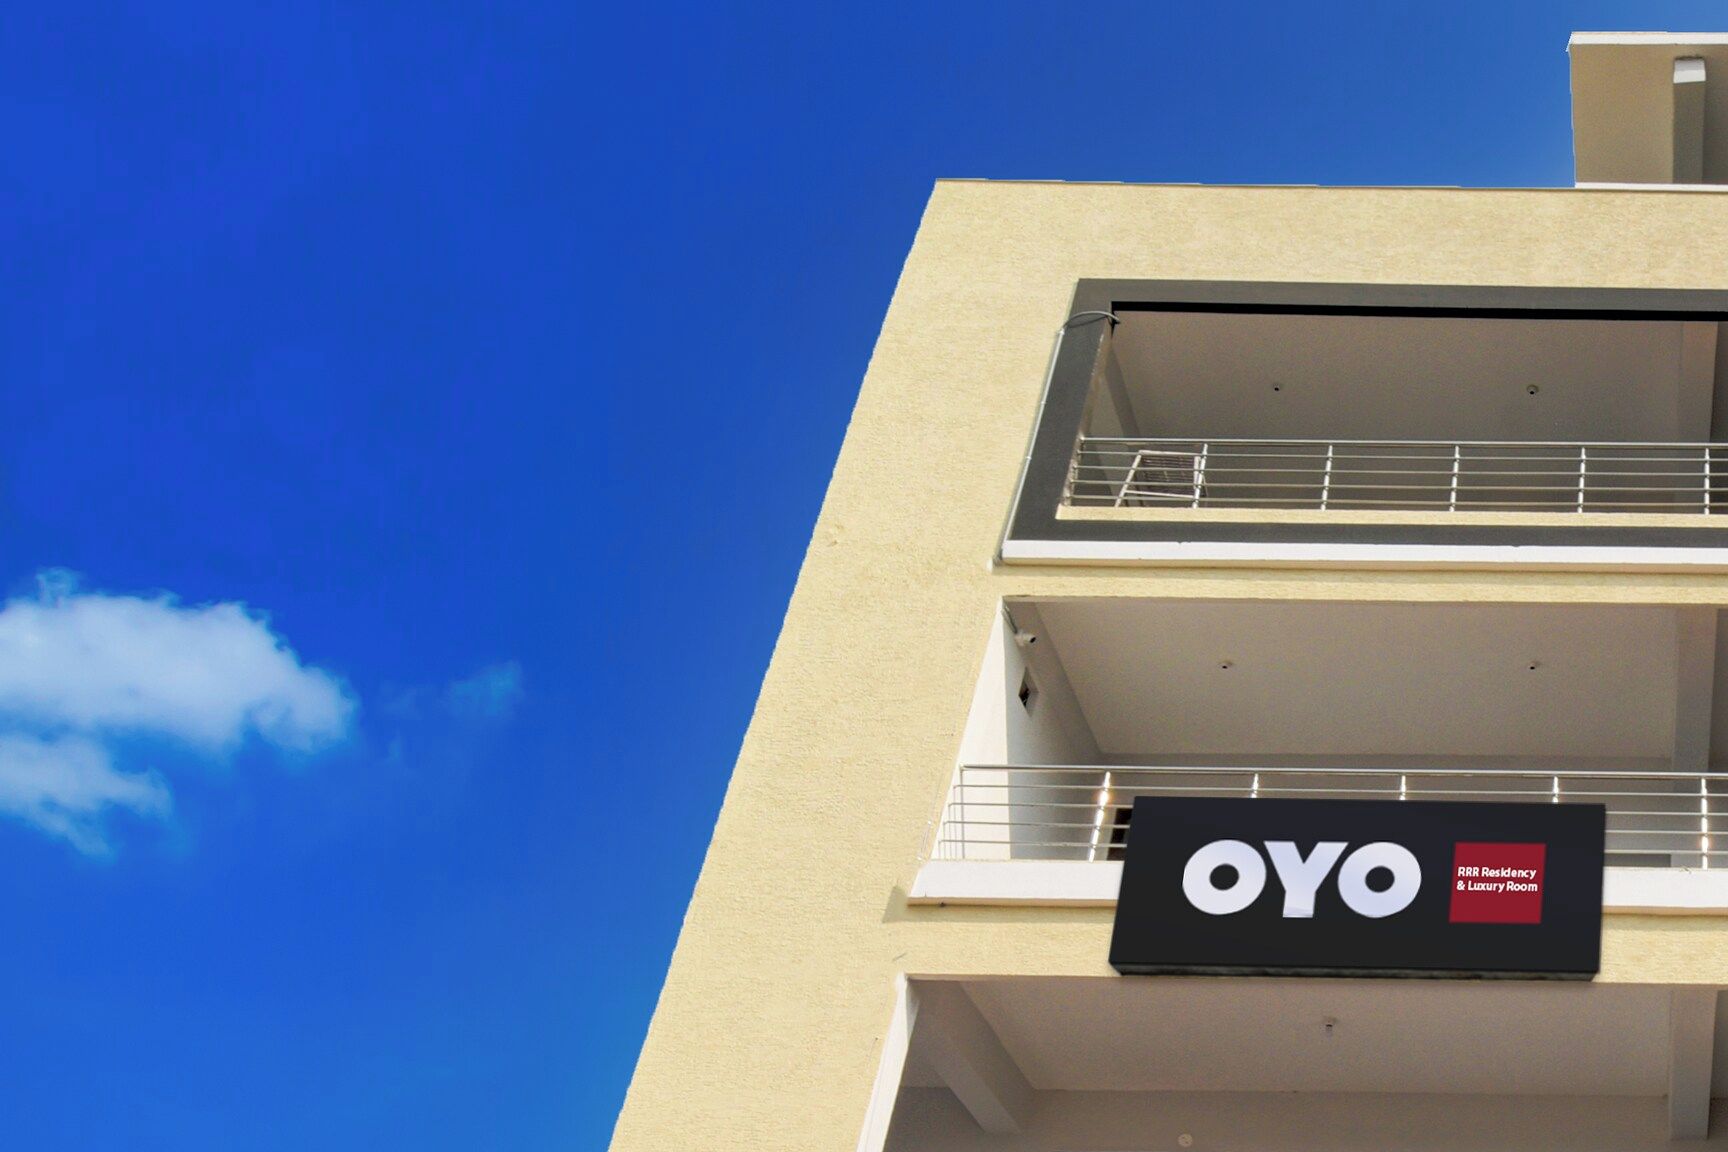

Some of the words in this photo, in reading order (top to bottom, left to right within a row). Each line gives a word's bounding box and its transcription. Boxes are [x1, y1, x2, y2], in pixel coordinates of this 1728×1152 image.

[1182, 839, 1422, 919] OYO
[1457, 866, 1479, 877] RRR
[1481, 866, 1537, 879] Residency
[1456, 880, 1465, 891] &
[1467, 880, 1505, 893] Luxury
[1506, 880, 1538, 892] Room
